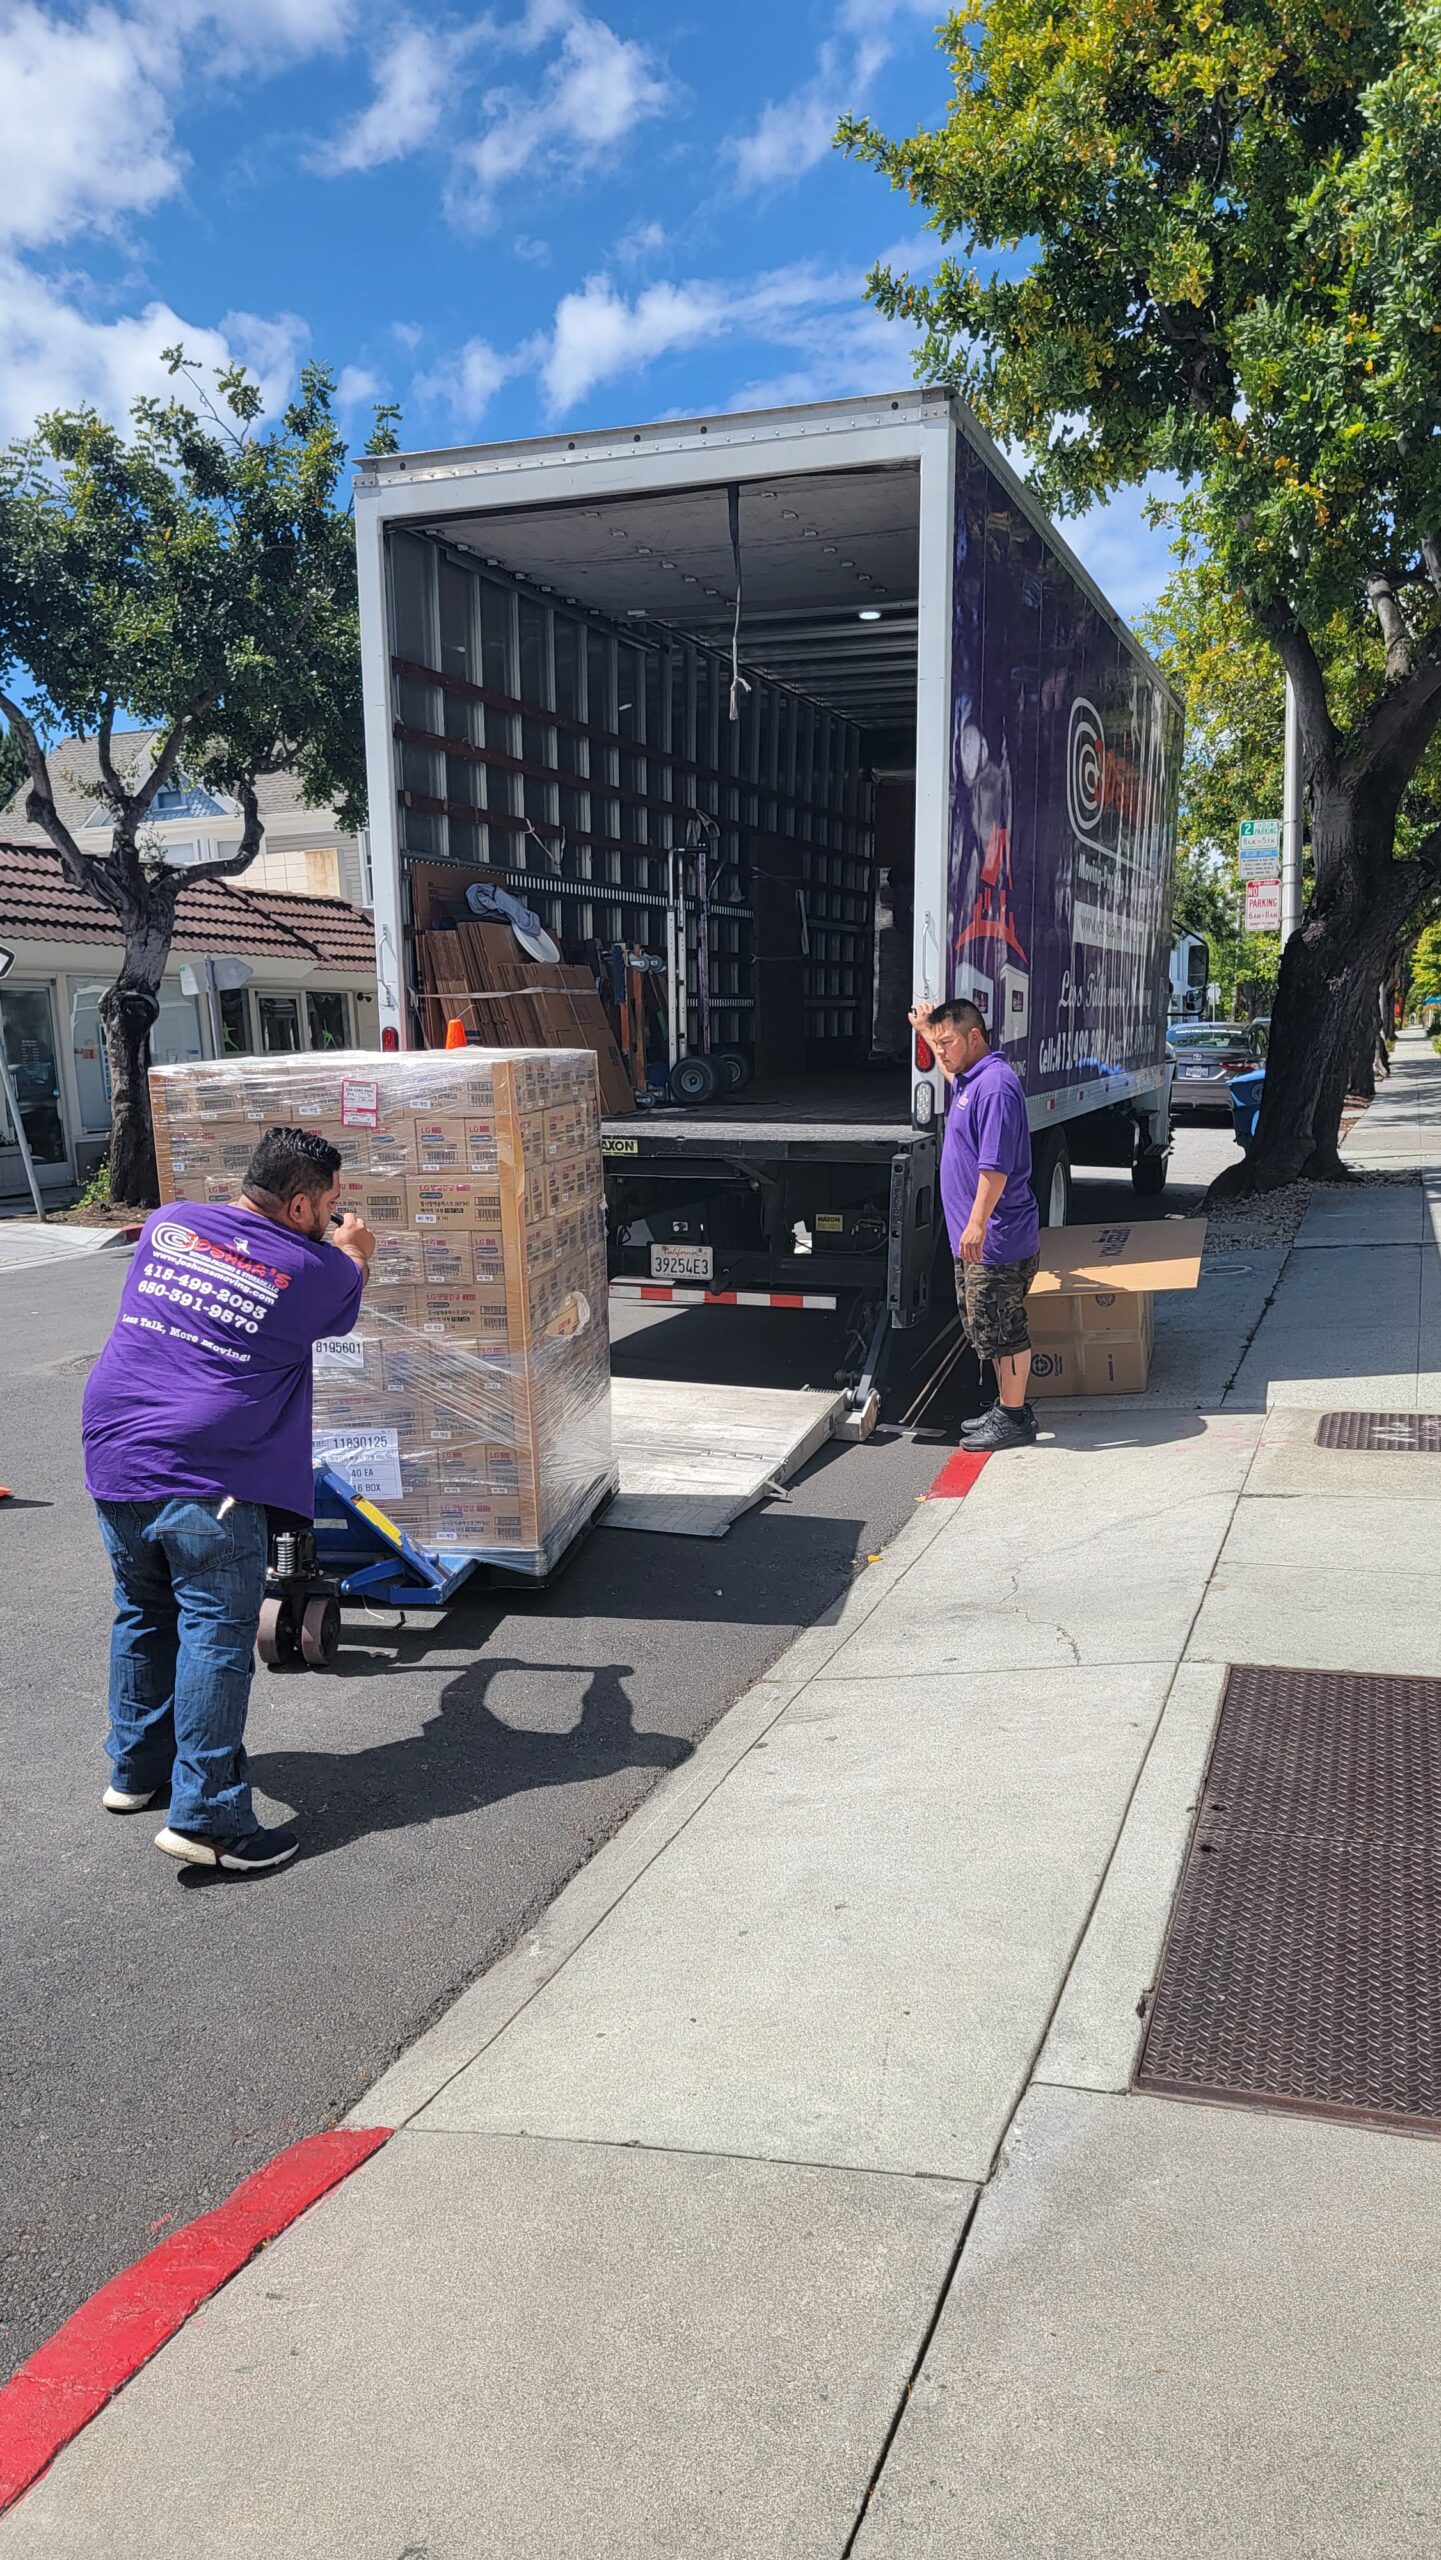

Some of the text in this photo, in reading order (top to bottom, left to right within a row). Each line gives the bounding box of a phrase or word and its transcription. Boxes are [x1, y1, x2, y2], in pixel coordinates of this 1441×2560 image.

[1244, 823, 1252, 835] 2
[1255, 827, 1277, 835] PARKING
[1248, 887, 1258, 896] NO
[1249, 898, 1278, 909] PARKING
[663, 1248, 698, 1258] California
[655, 1256, 709, 1275] 39254E3
[144, 1263, 267, 1320] 415-499-2093
[138, 1280, 259, 1334] 650-391-9570
[122, 1313, 251, 1362] Less Talk, More Moving!
[315, 1341, 361, 1355] 8195601
[333, 1435, 388, 1449] 11830125
[351, 1467, 374, 1478] 40 EA
[365, 1483, 381, 1492] BOX
